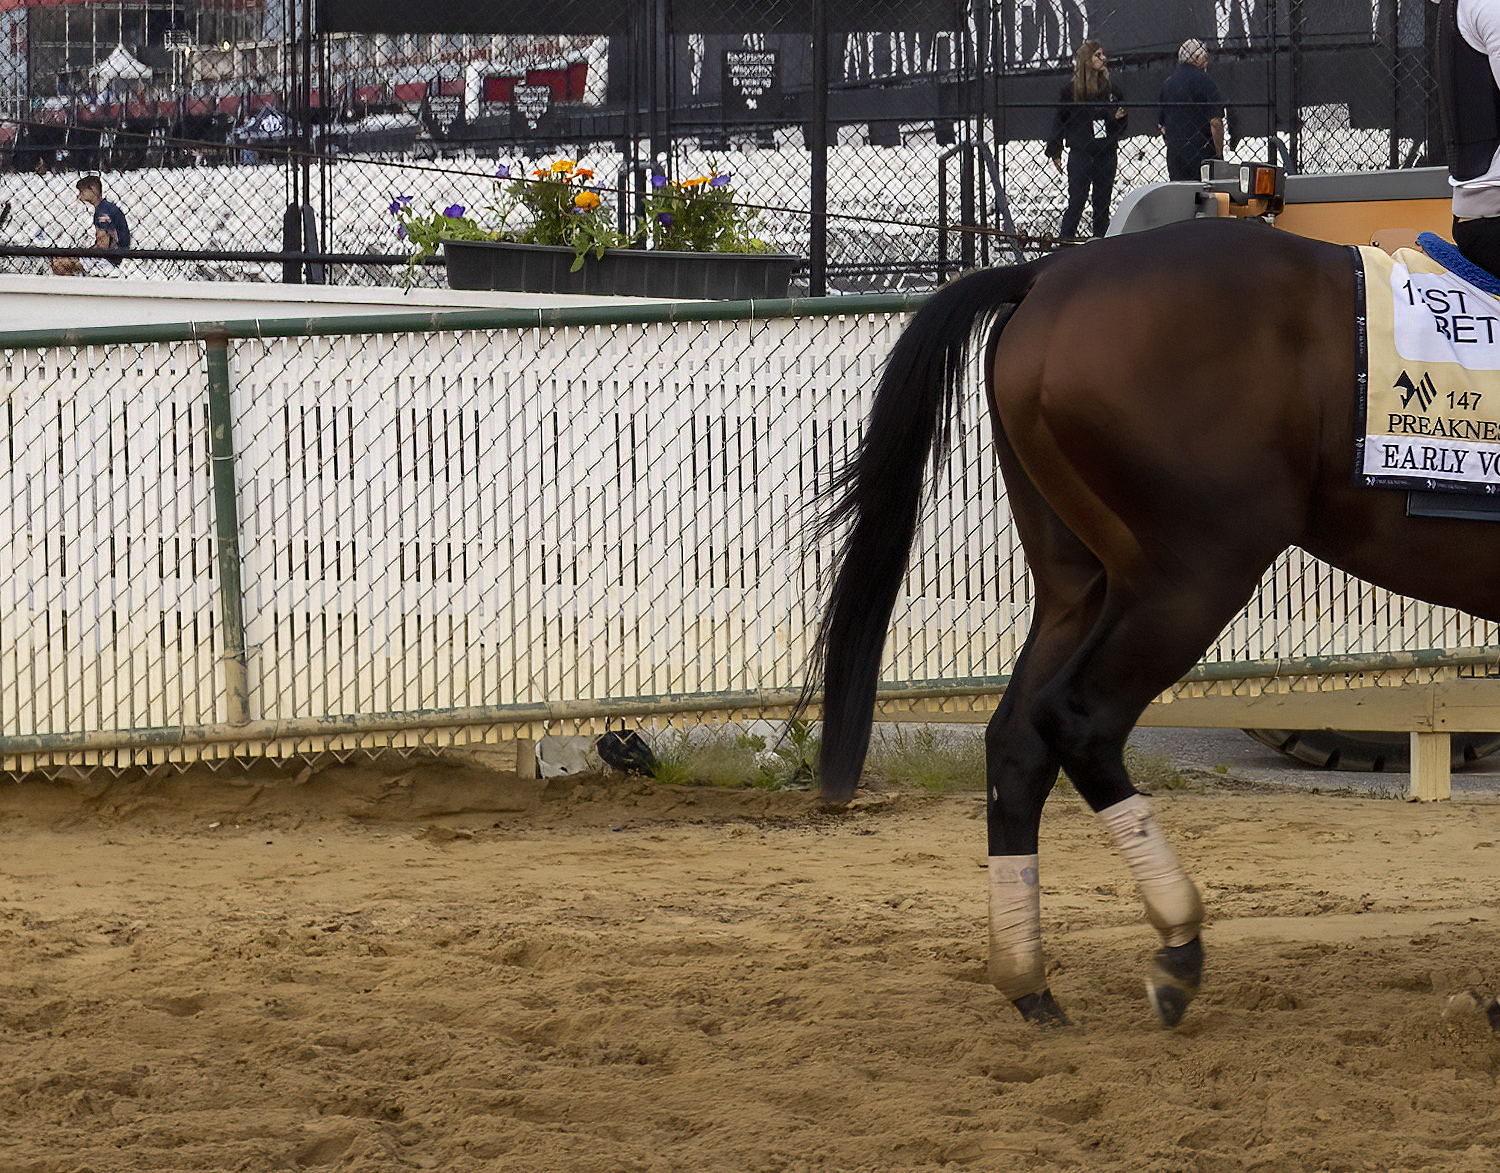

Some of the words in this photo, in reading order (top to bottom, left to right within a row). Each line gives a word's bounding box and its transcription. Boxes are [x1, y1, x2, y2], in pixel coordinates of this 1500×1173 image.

[1434, 315, 1499, 344] BET
[1446, 390, 1483, 411] 147
[1381, 444, 1470, 474] EARLY
